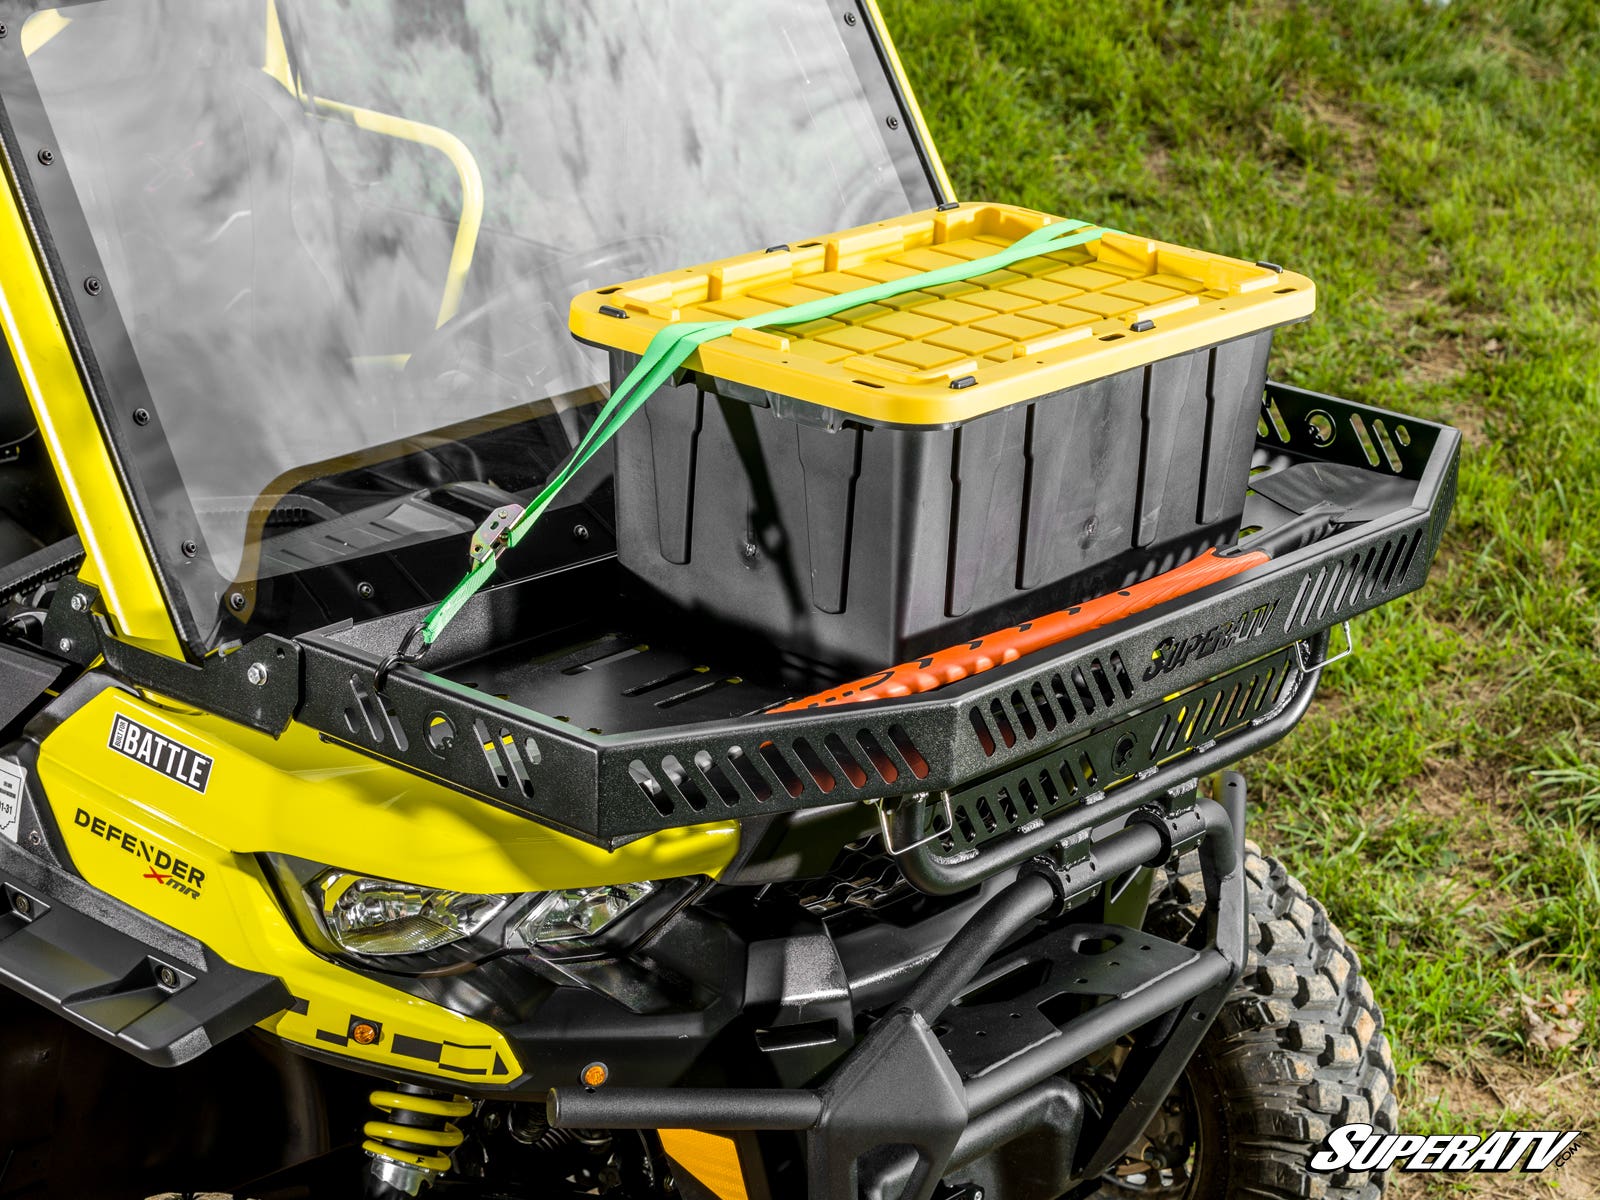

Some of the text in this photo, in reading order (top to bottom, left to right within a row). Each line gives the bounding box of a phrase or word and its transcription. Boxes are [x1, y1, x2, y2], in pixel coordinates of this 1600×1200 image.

[1142, 599, 1280, 682] SUPERATV
[114, 732, 123, 747] BUILT
[123, 723, 207, 788] BATTLE
[0, 801, 13, 815] 1-31
[73, 807, 206, 889] DEFENDER
